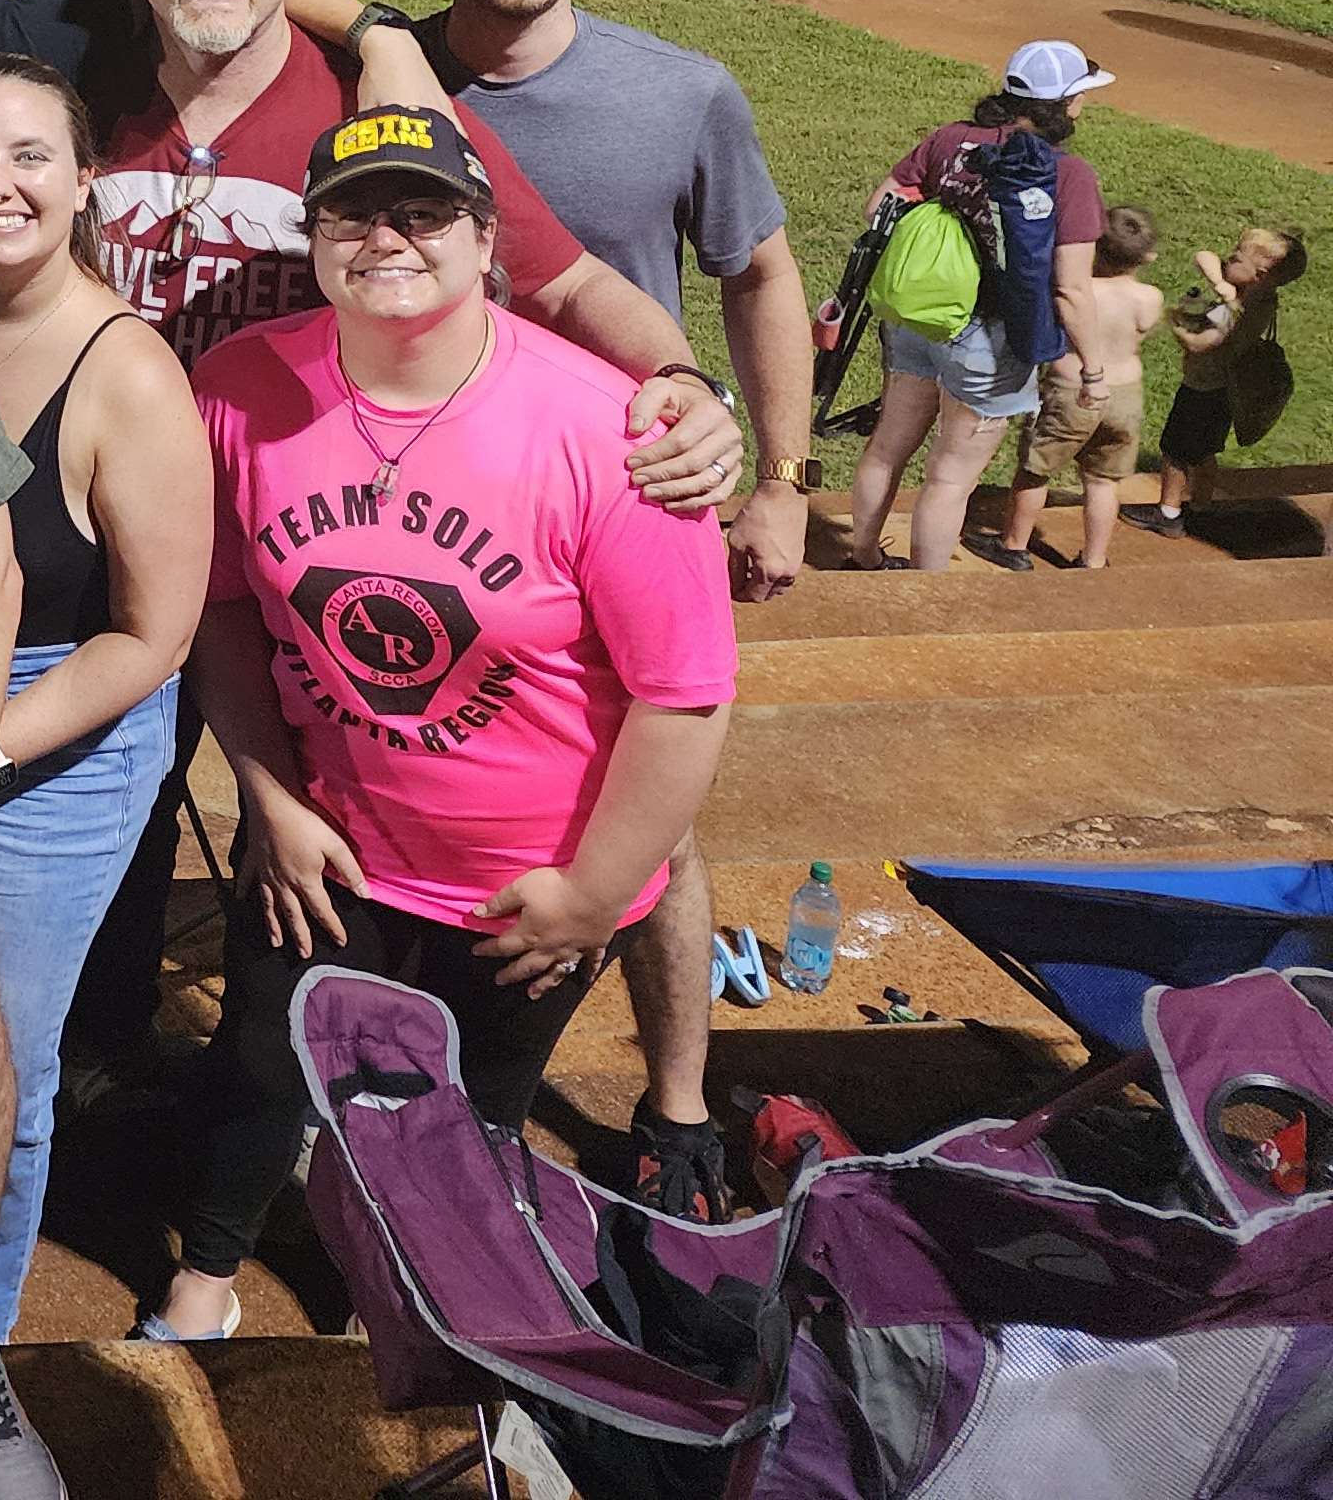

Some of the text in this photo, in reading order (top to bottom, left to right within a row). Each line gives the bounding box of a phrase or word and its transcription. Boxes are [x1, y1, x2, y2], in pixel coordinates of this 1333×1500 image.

[99, 241, 310, 317] IVE FREE
[256, 483, 524, 592] TEAM SOLO
[324, 579, 446, 640] ATLANTA REGION
[277, 638, 519, 755] ATLANTA REGION
[368, 668, 419, 687] SCCA
